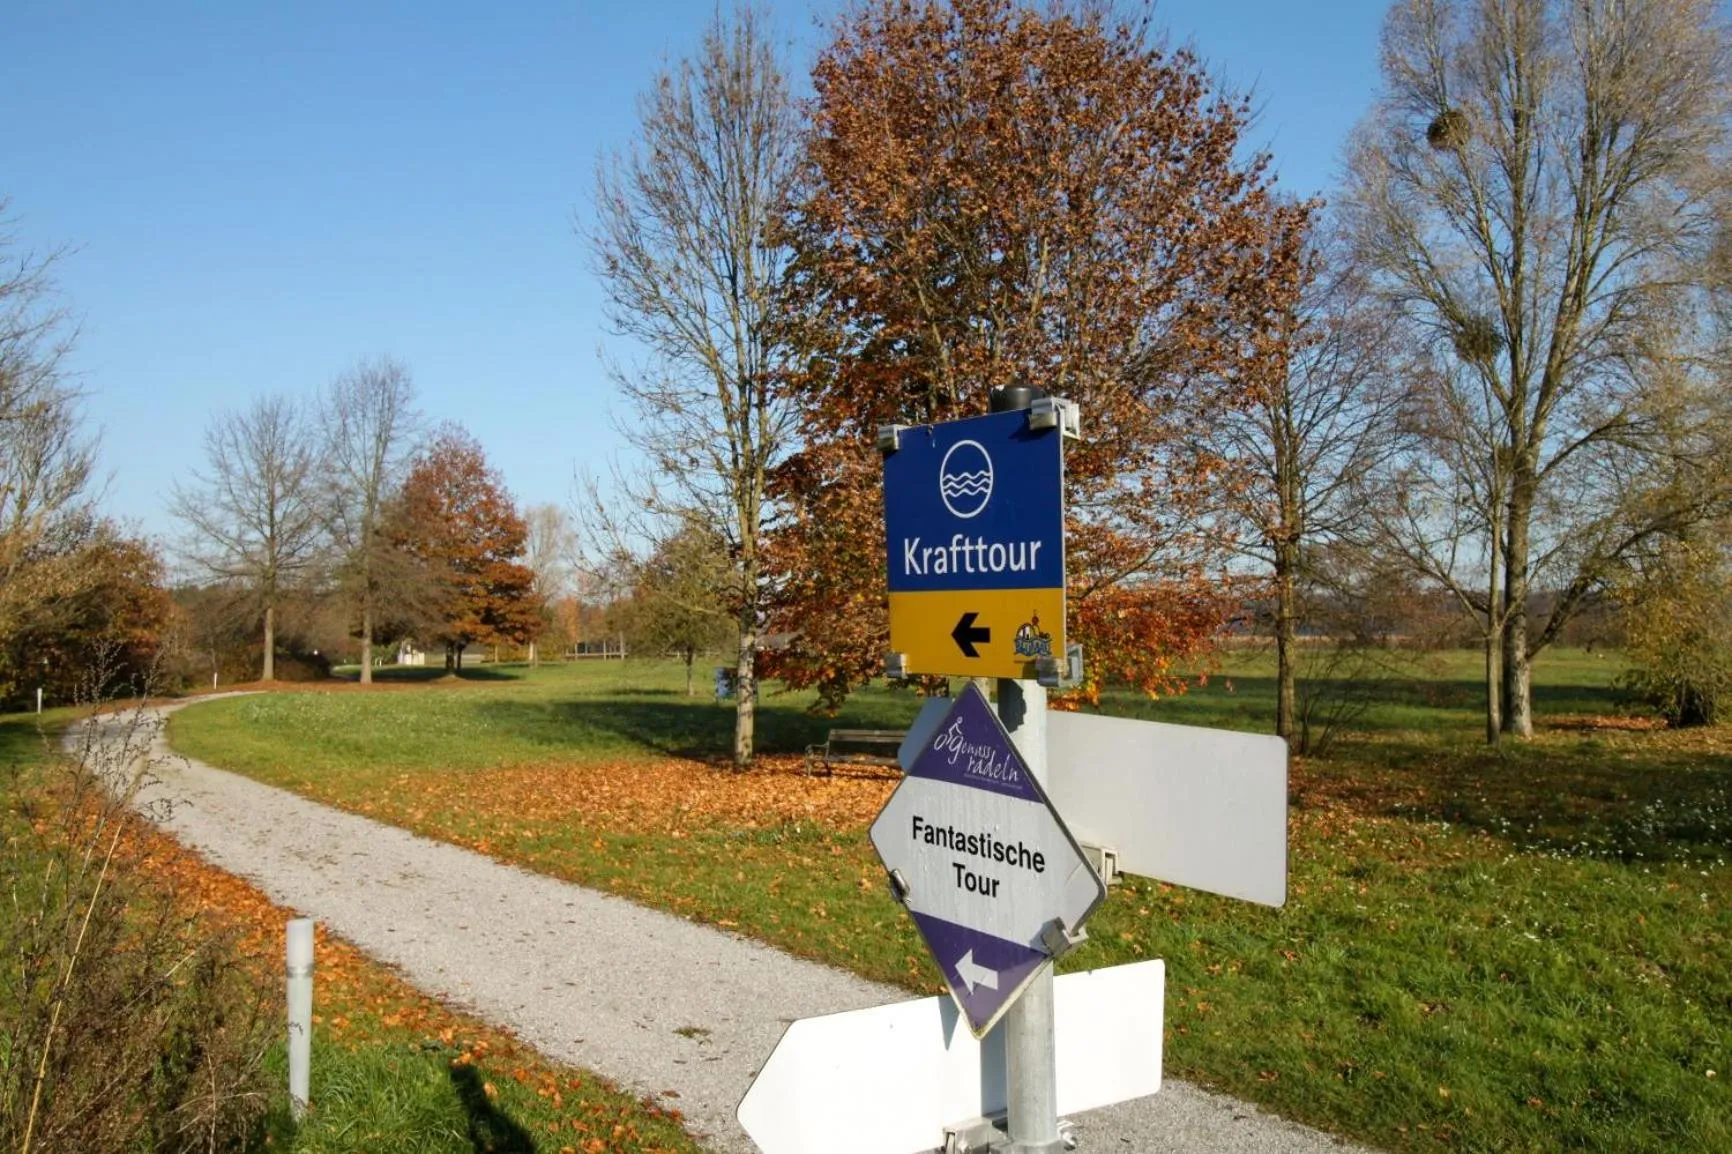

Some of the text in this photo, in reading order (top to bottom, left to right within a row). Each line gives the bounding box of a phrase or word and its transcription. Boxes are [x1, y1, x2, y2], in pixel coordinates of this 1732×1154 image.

[904, 534, 1042, 575] Krafttour
[967, 750, 1018, 781] radeln
[912, 815, 1046, 873] Fantastische
[952, 862, 1001, 899] Tour
